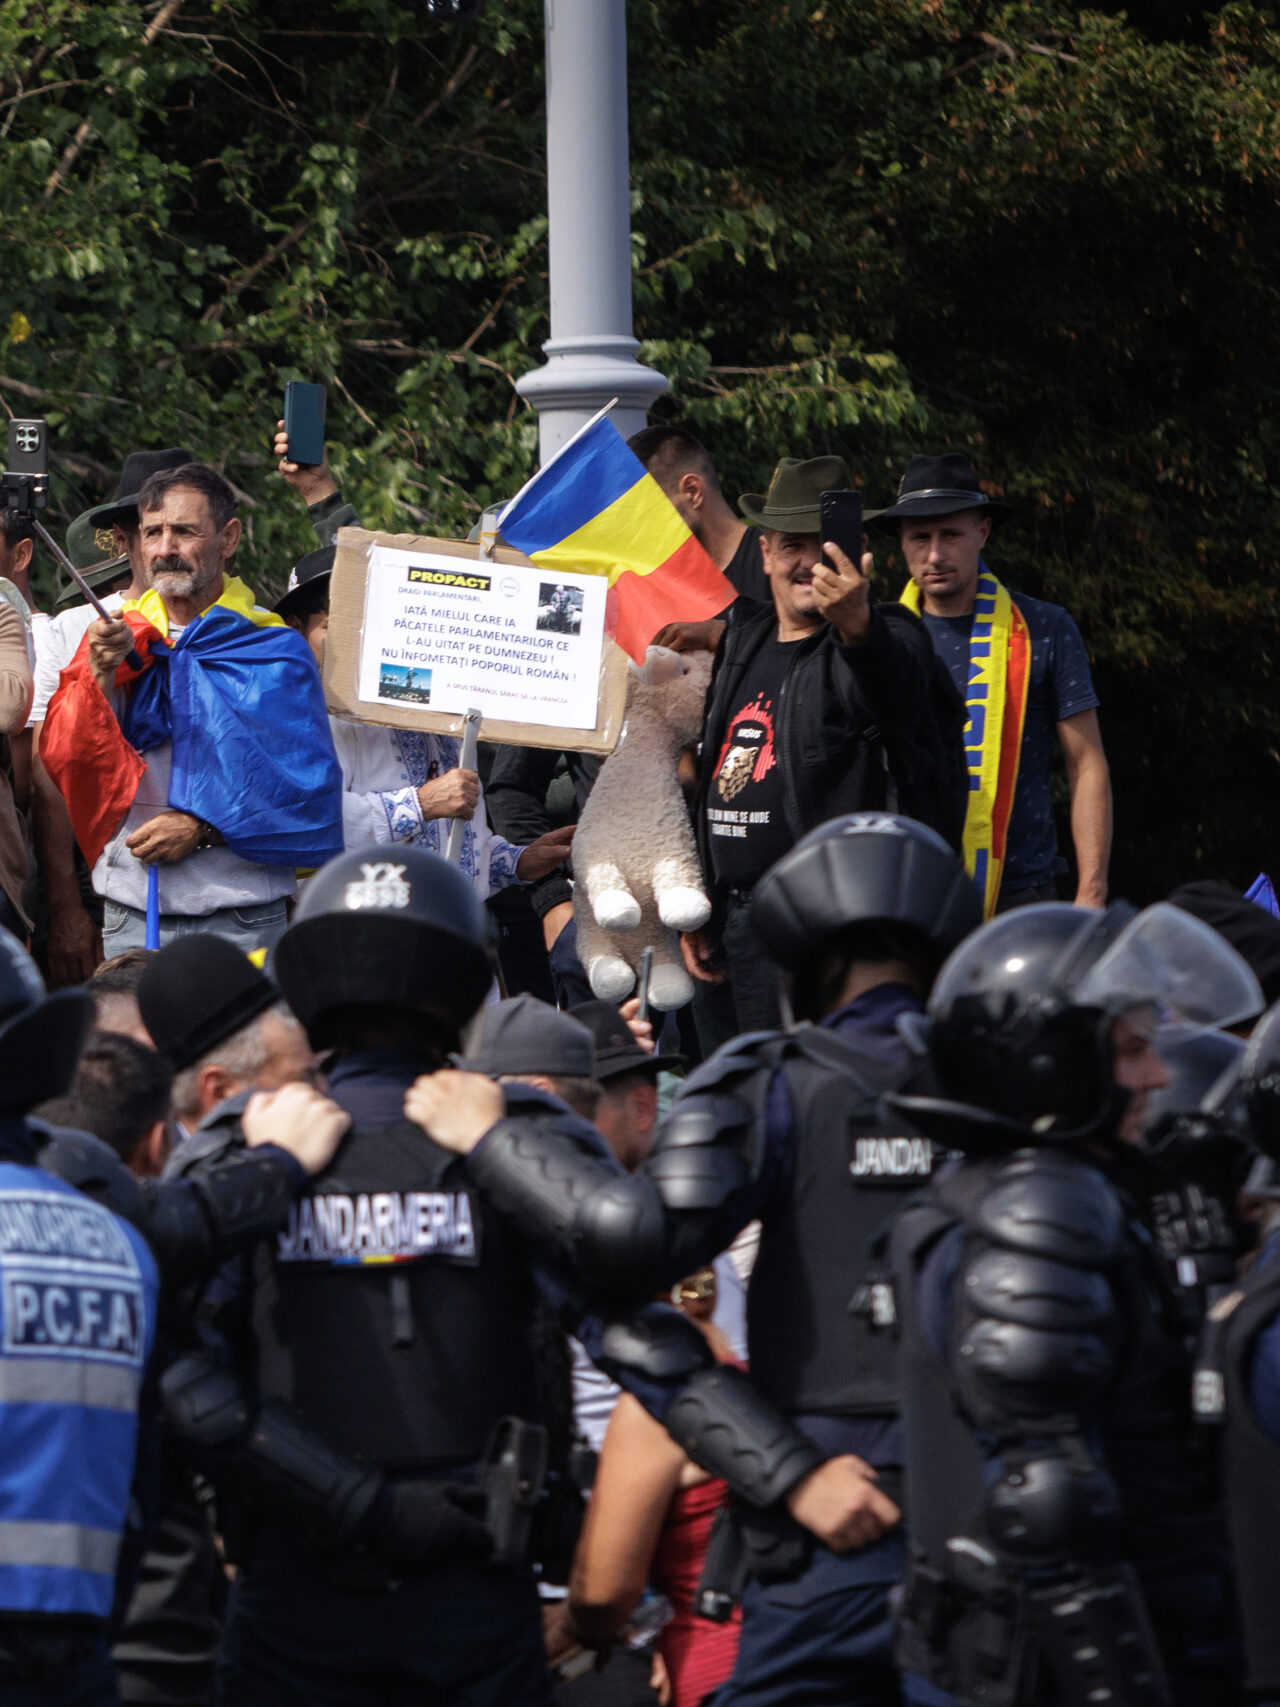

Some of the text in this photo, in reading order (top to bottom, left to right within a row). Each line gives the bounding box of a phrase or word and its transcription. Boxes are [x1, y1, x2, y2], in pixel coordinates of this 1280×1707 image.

[398, 586, 421, 595] DRAGI
[410, 570, 489, 590] PROPACT
[404, 605, 516, 628] IATĂ MIELUL CARE IA
[394, 618, 569, 651] PĂCATELE PARLAMENTARILOR CE
[406, 636, 432, 647] L-AU
[435, 639, 465, 651] UITAT
[468, 643, 482, 653] PE
[484, 645, 548, 663] DUMNEZEU
[381, 647, 399, 658] NU
[471, 659, 523, 676] POPORUL
[526, 667, 569, 681] ROMÂN
[739, 811, 749, 823] SE
[749, 811, 770, 823] AUDE
[277, 1191, 476, 1256] JANDARMERIA
